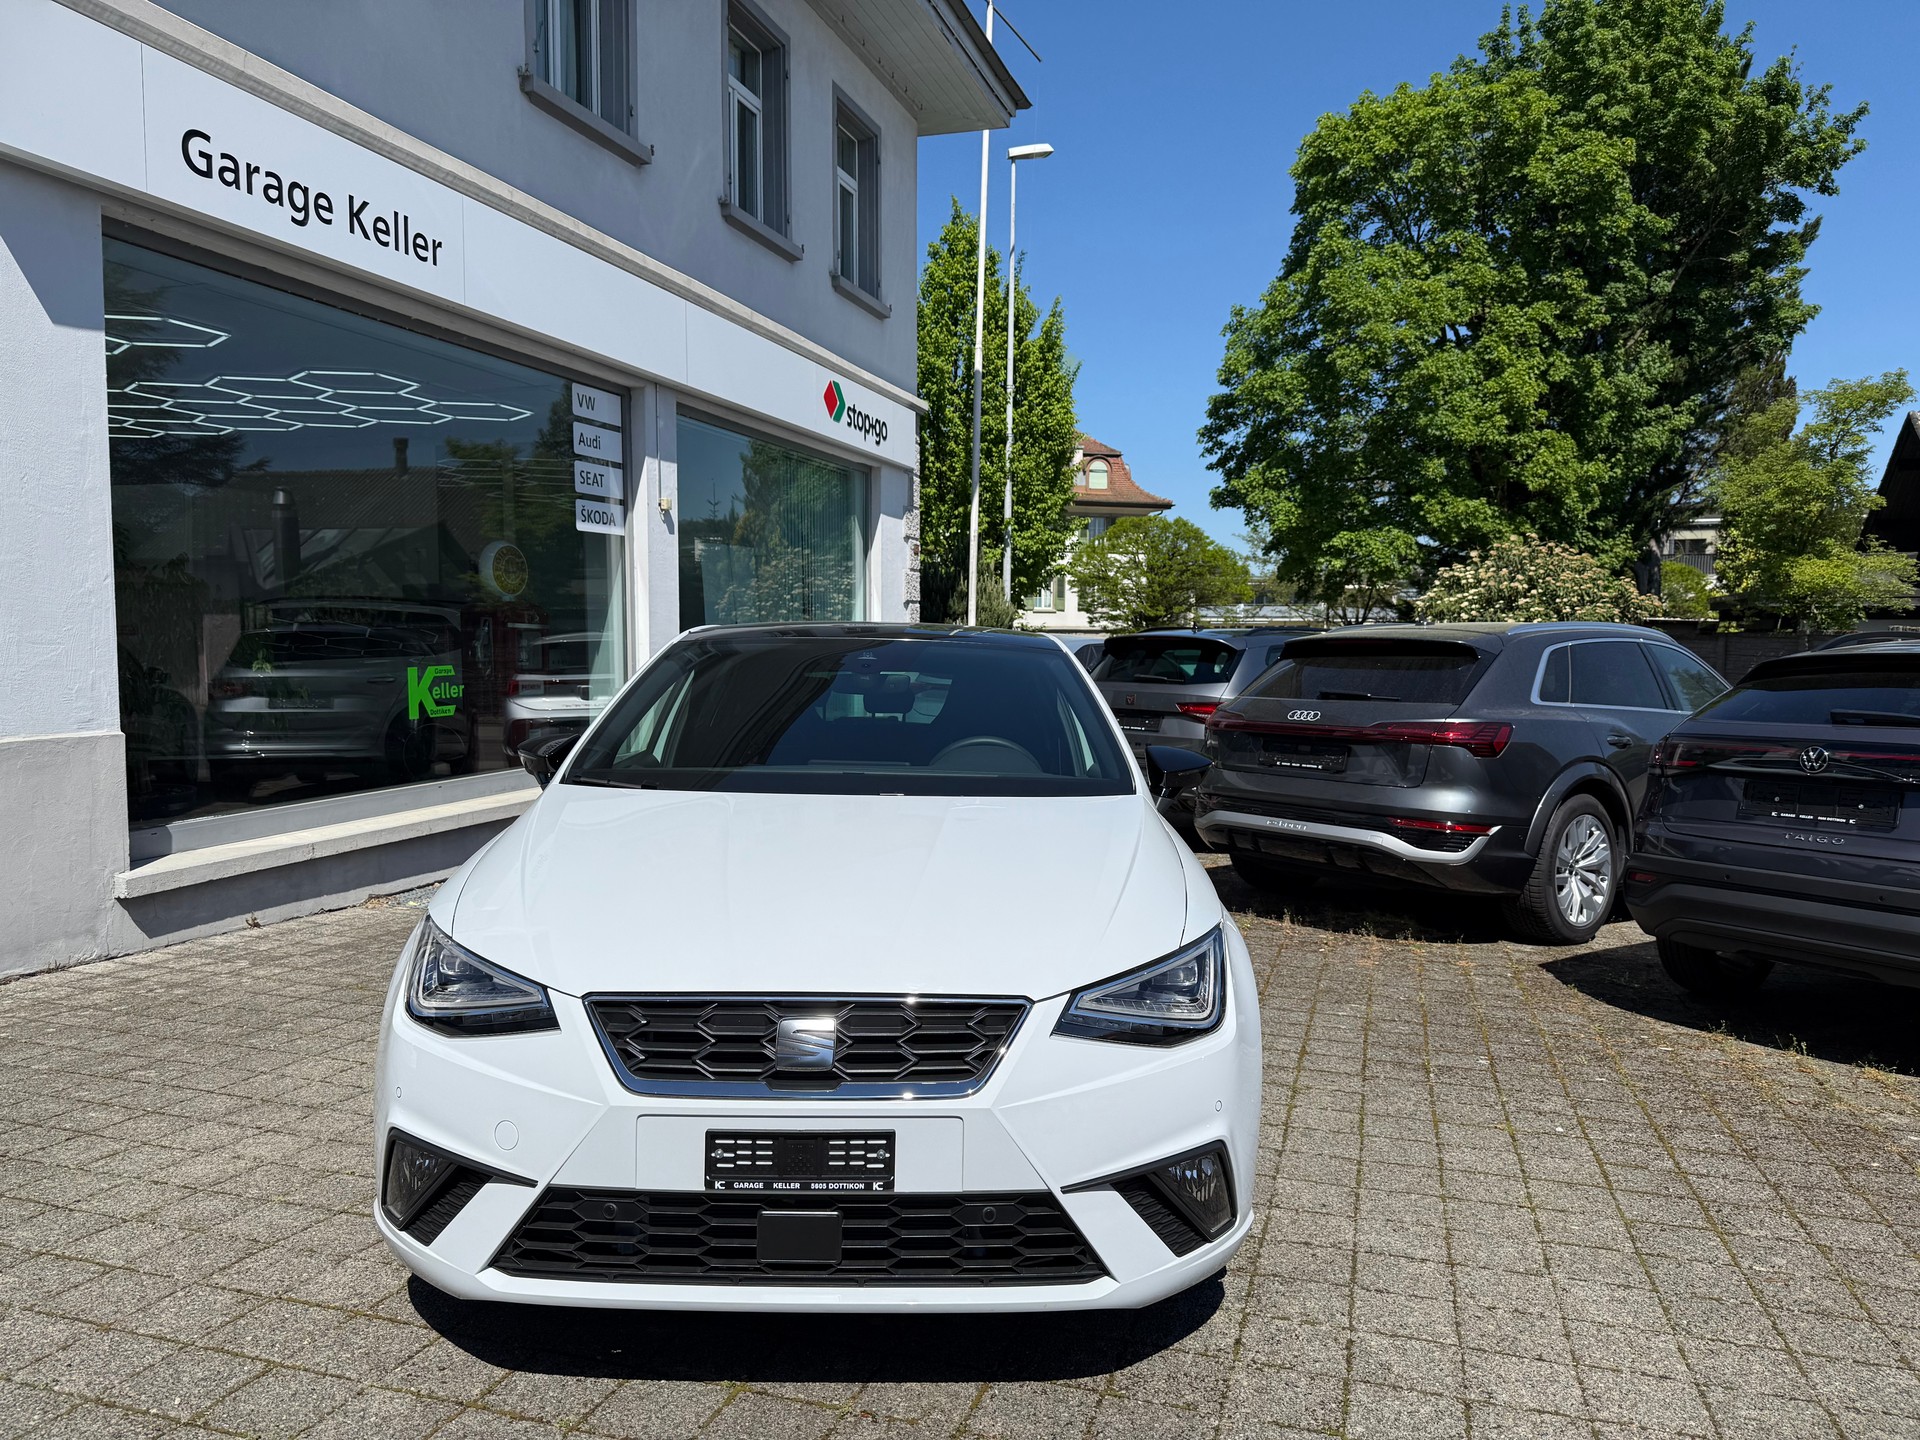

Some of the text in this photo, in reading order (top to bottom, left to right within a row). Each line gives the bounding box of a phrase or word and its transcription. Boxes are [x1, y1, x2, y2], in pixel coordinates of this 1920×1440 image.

[181, 128, 443, 267] Garage Keller
[576, 392, 596, 411] VW
[847, 403, 888, 446] stop+go
[578, 432, 601, 450] Audi
[579, 470, 604, 488] SEAT
[581, 505, 616, 527] ŠKODA
[407, 666, 465, 720] Keller
[1784, 832, 1845, 845] TAIGO
